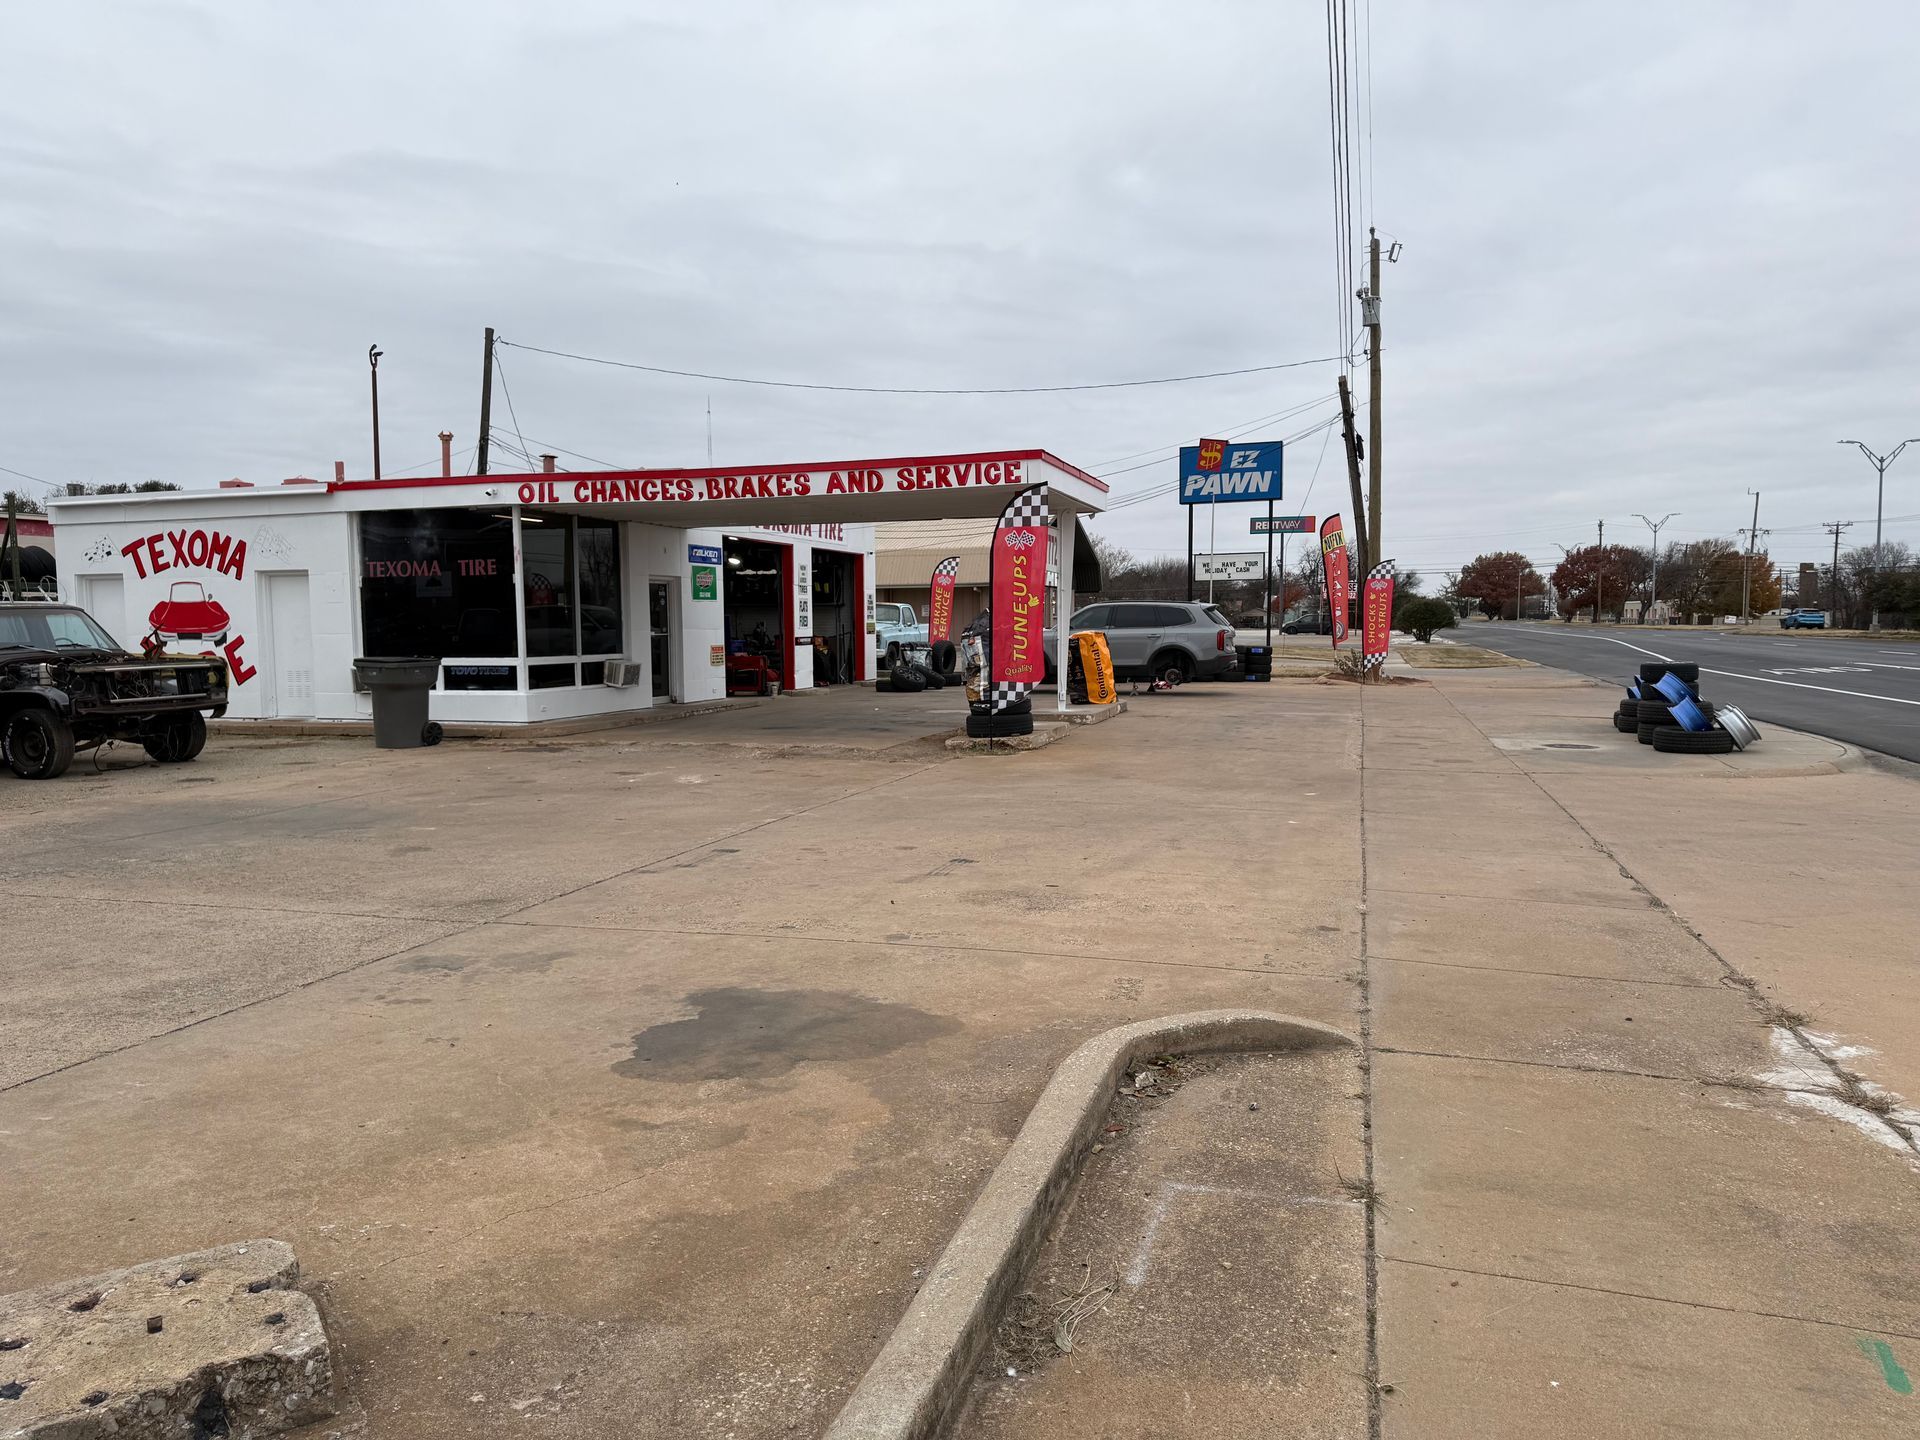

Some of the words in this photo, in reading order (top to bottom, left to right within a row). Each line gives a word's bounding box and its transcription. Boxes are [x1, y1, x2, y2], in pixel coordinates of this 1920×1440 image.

[1230, 450, 1260, 469] EZ
[518, 482, 559, 503] OIL
[705, 473, 811, 499] BRAKES
[826, 470, 884, 494] AND
[897, 461, 1022, 490] SERVICE
[1184, 471, 1273, 496] PAWN
[121, 529, 247, 581] TEXOMA
[366, 560, 442, 577] TEXOMA
[458, 559, 497, 577] TIRE
[933, 586, 943, 624] BRAKE
[939, 591, 951, 639] SERVICE
[1013, 555, 1028, 661] TUNE-UPS
[1368, 604, 1377, 644] SHOCKS
[1378, 592, 1388, 628] STRUTS
[1005, 664, 1033, 676] Quality
[1092, 649, 1109, 698] Continental
